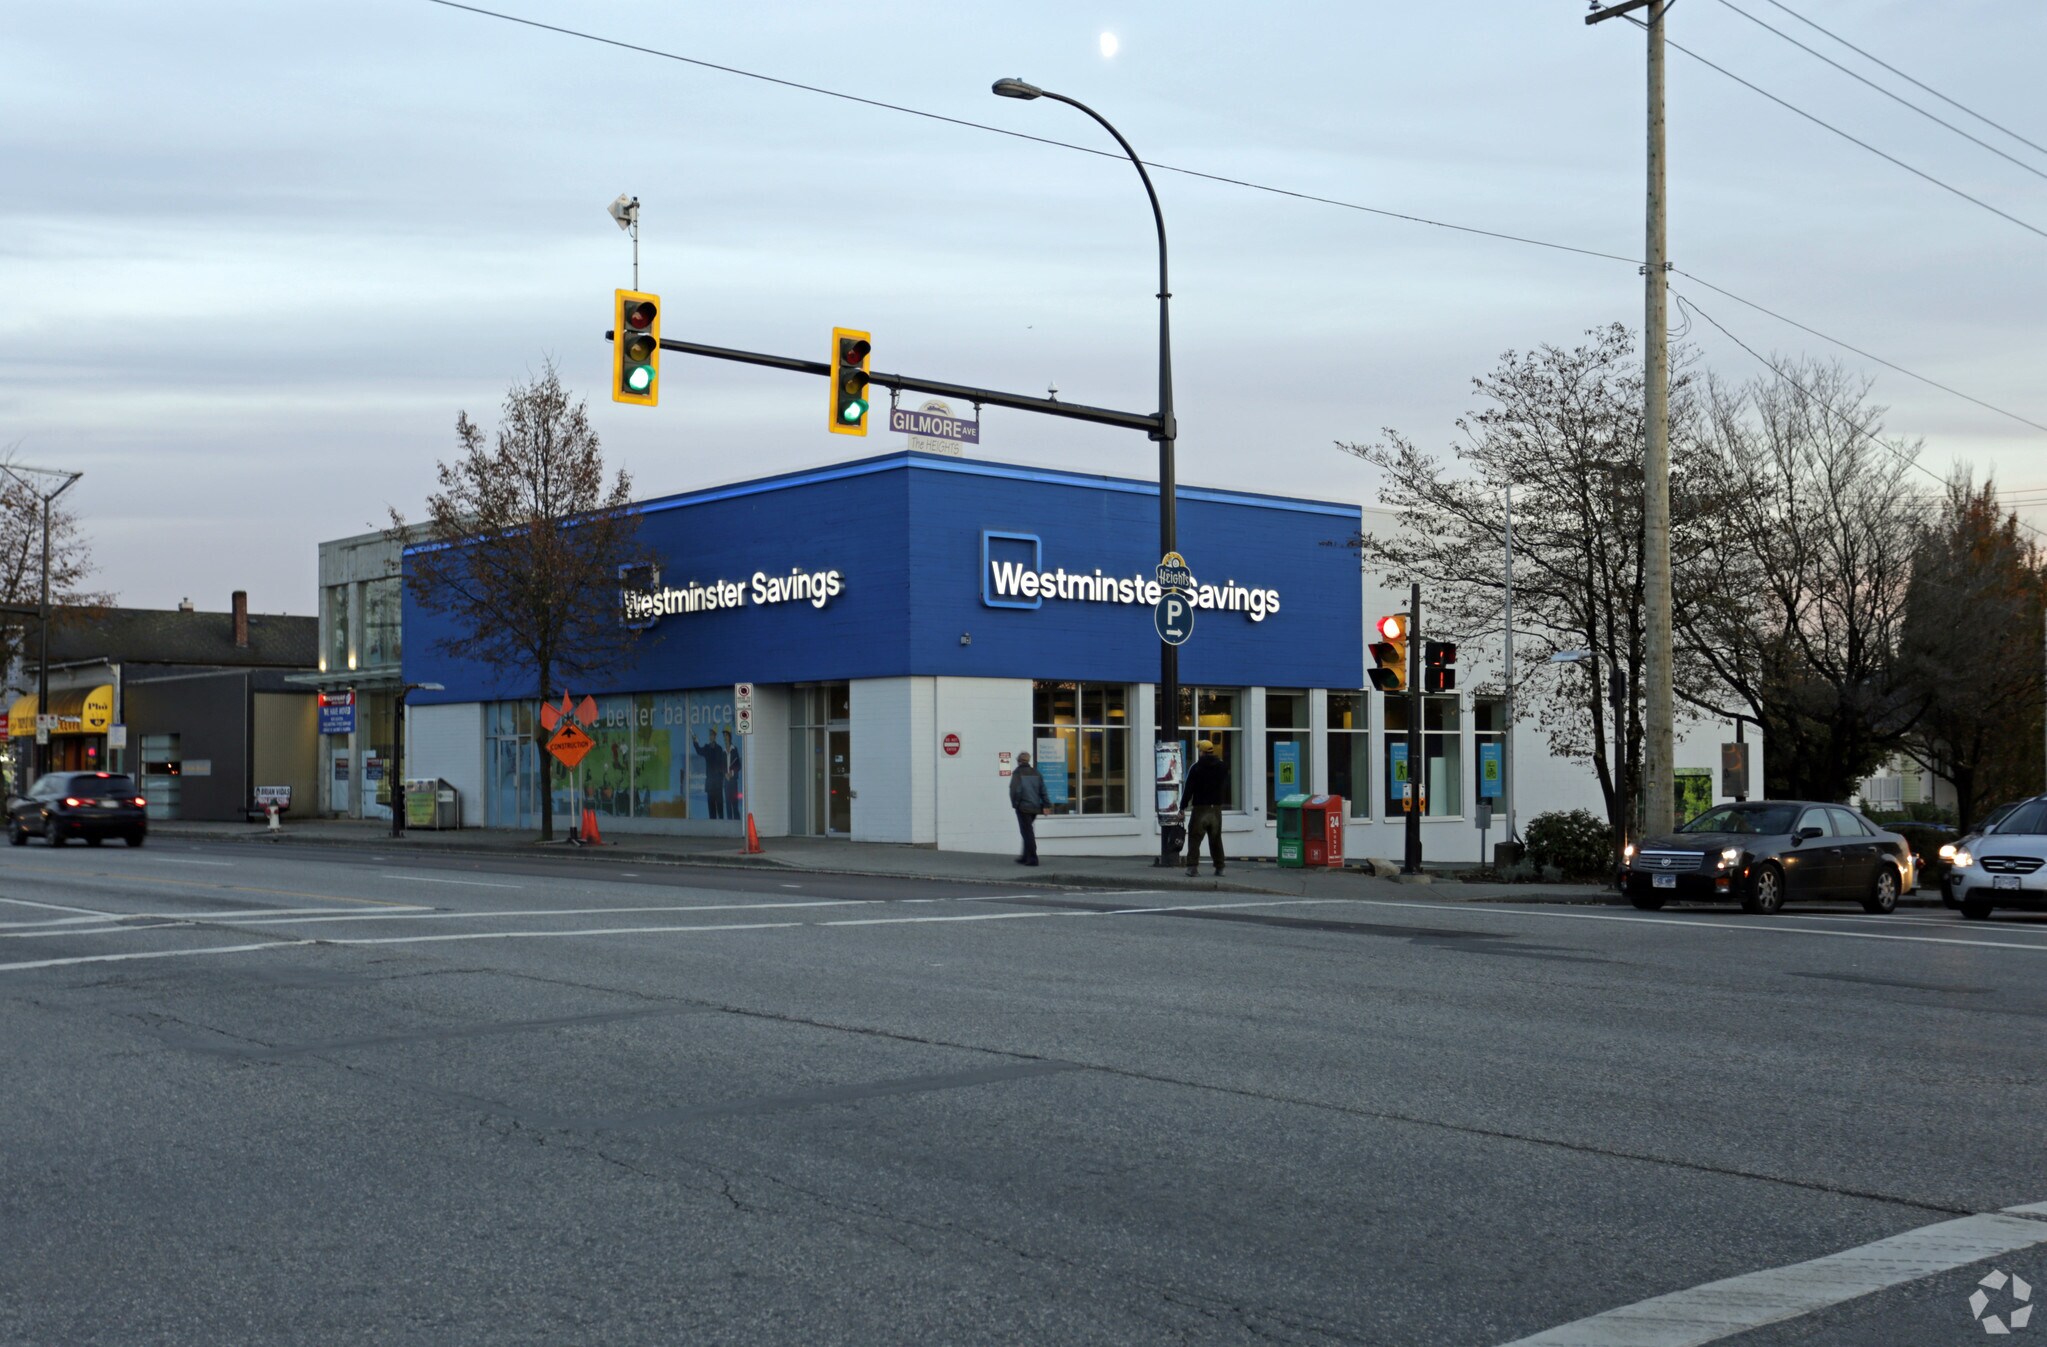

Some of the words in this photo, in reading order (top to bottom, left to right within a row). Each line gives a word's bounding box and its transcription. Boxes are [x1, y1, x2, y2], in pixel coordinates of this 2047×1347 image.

[893, 412, 962, 438] GILMORE
[962, 427, 977, 437] AVE
[926, 439, 960, 455] HEIGHTS
[992, 561, 1161, 605] Westminste
[1159, 569, 1190, 587] Heights
[623, 580, 747, 619] Westminster
[752, 568, 842, 608] Savings
[1167, 600, 1183, 626] P
[606, 703, 657, 728] better
[664, 698, 732, 726] baance
[550, 740, 589, 751] CONSTRUCTION
[1330, 816, 1340, 828] 24
